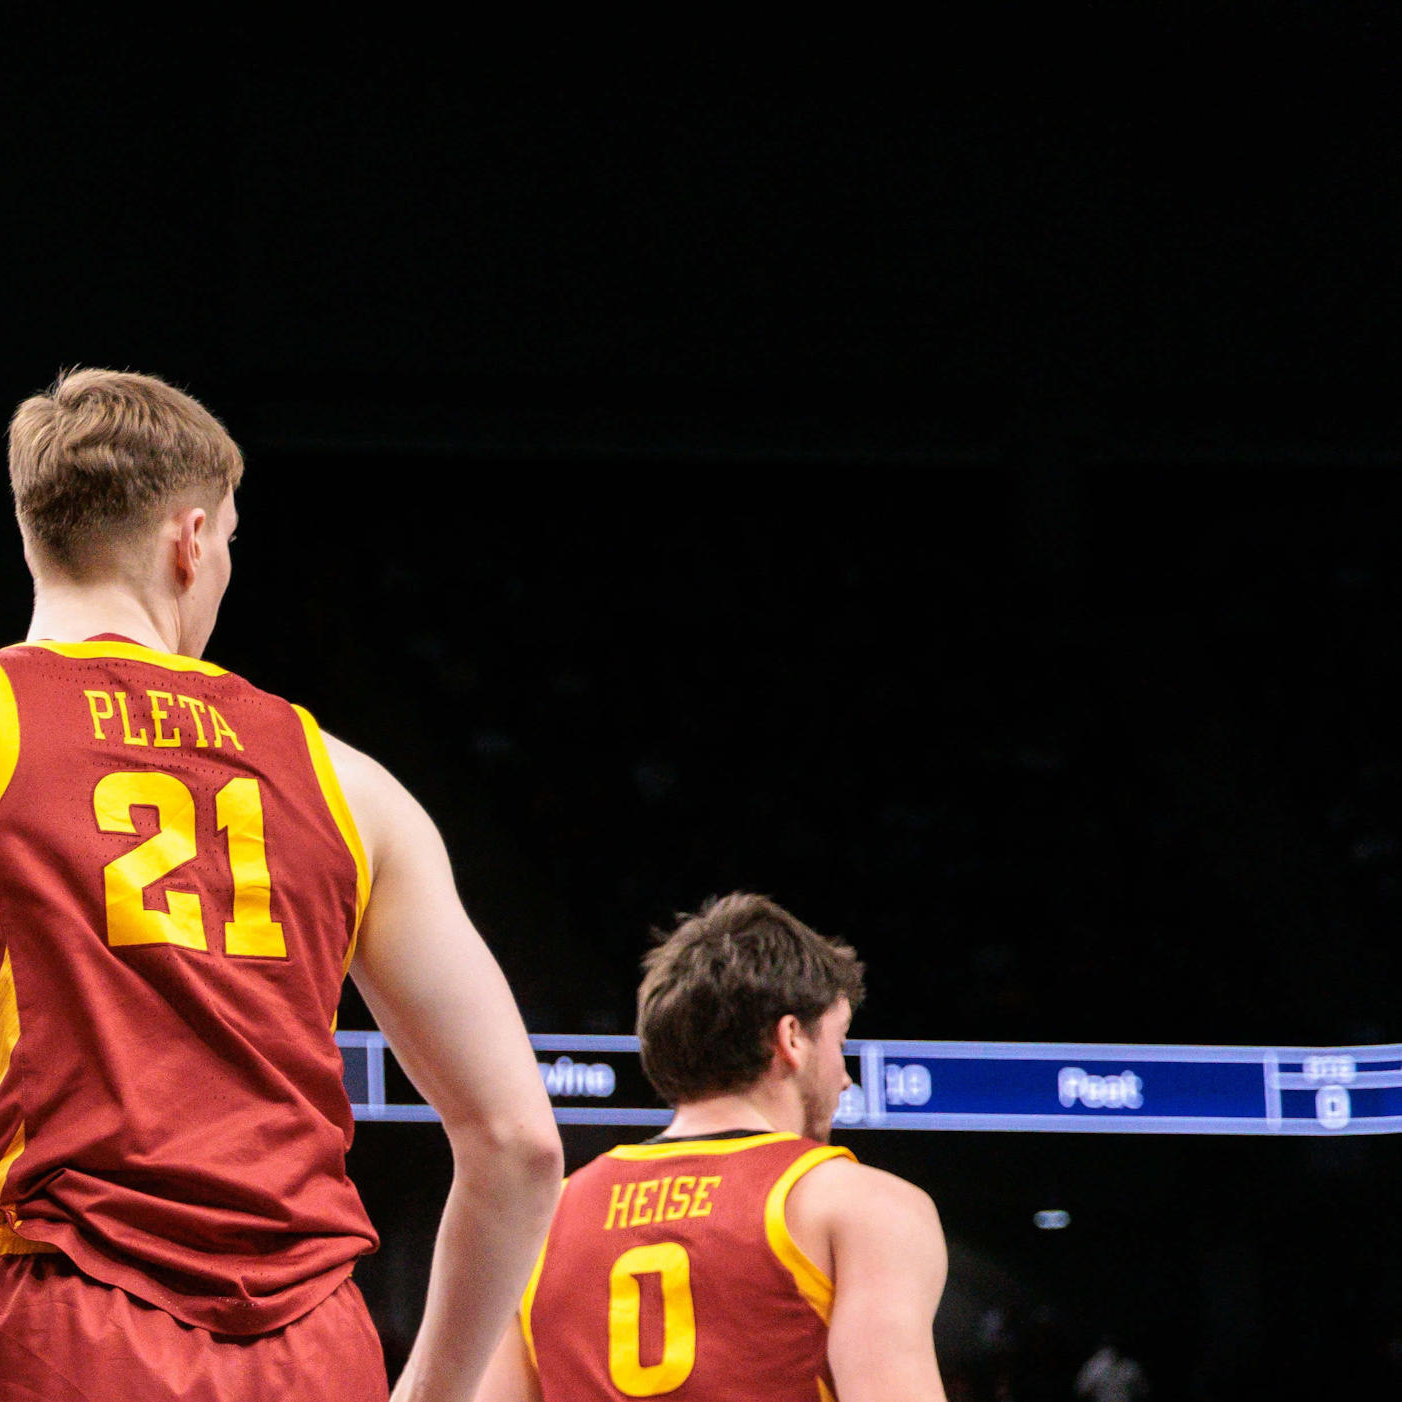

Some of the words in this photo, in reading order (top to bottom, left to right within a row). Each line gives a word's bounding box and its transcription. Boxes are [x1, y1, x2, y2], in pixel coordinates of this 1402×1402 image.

[83, 689, 245, 752] PLETA
[93, 770, 289, 960] 21
[1058, 1066, 1144, 1110] Peat
[603, 1175, 722, 1231] HEISE
[607, 1241, 698, 1398] 0
